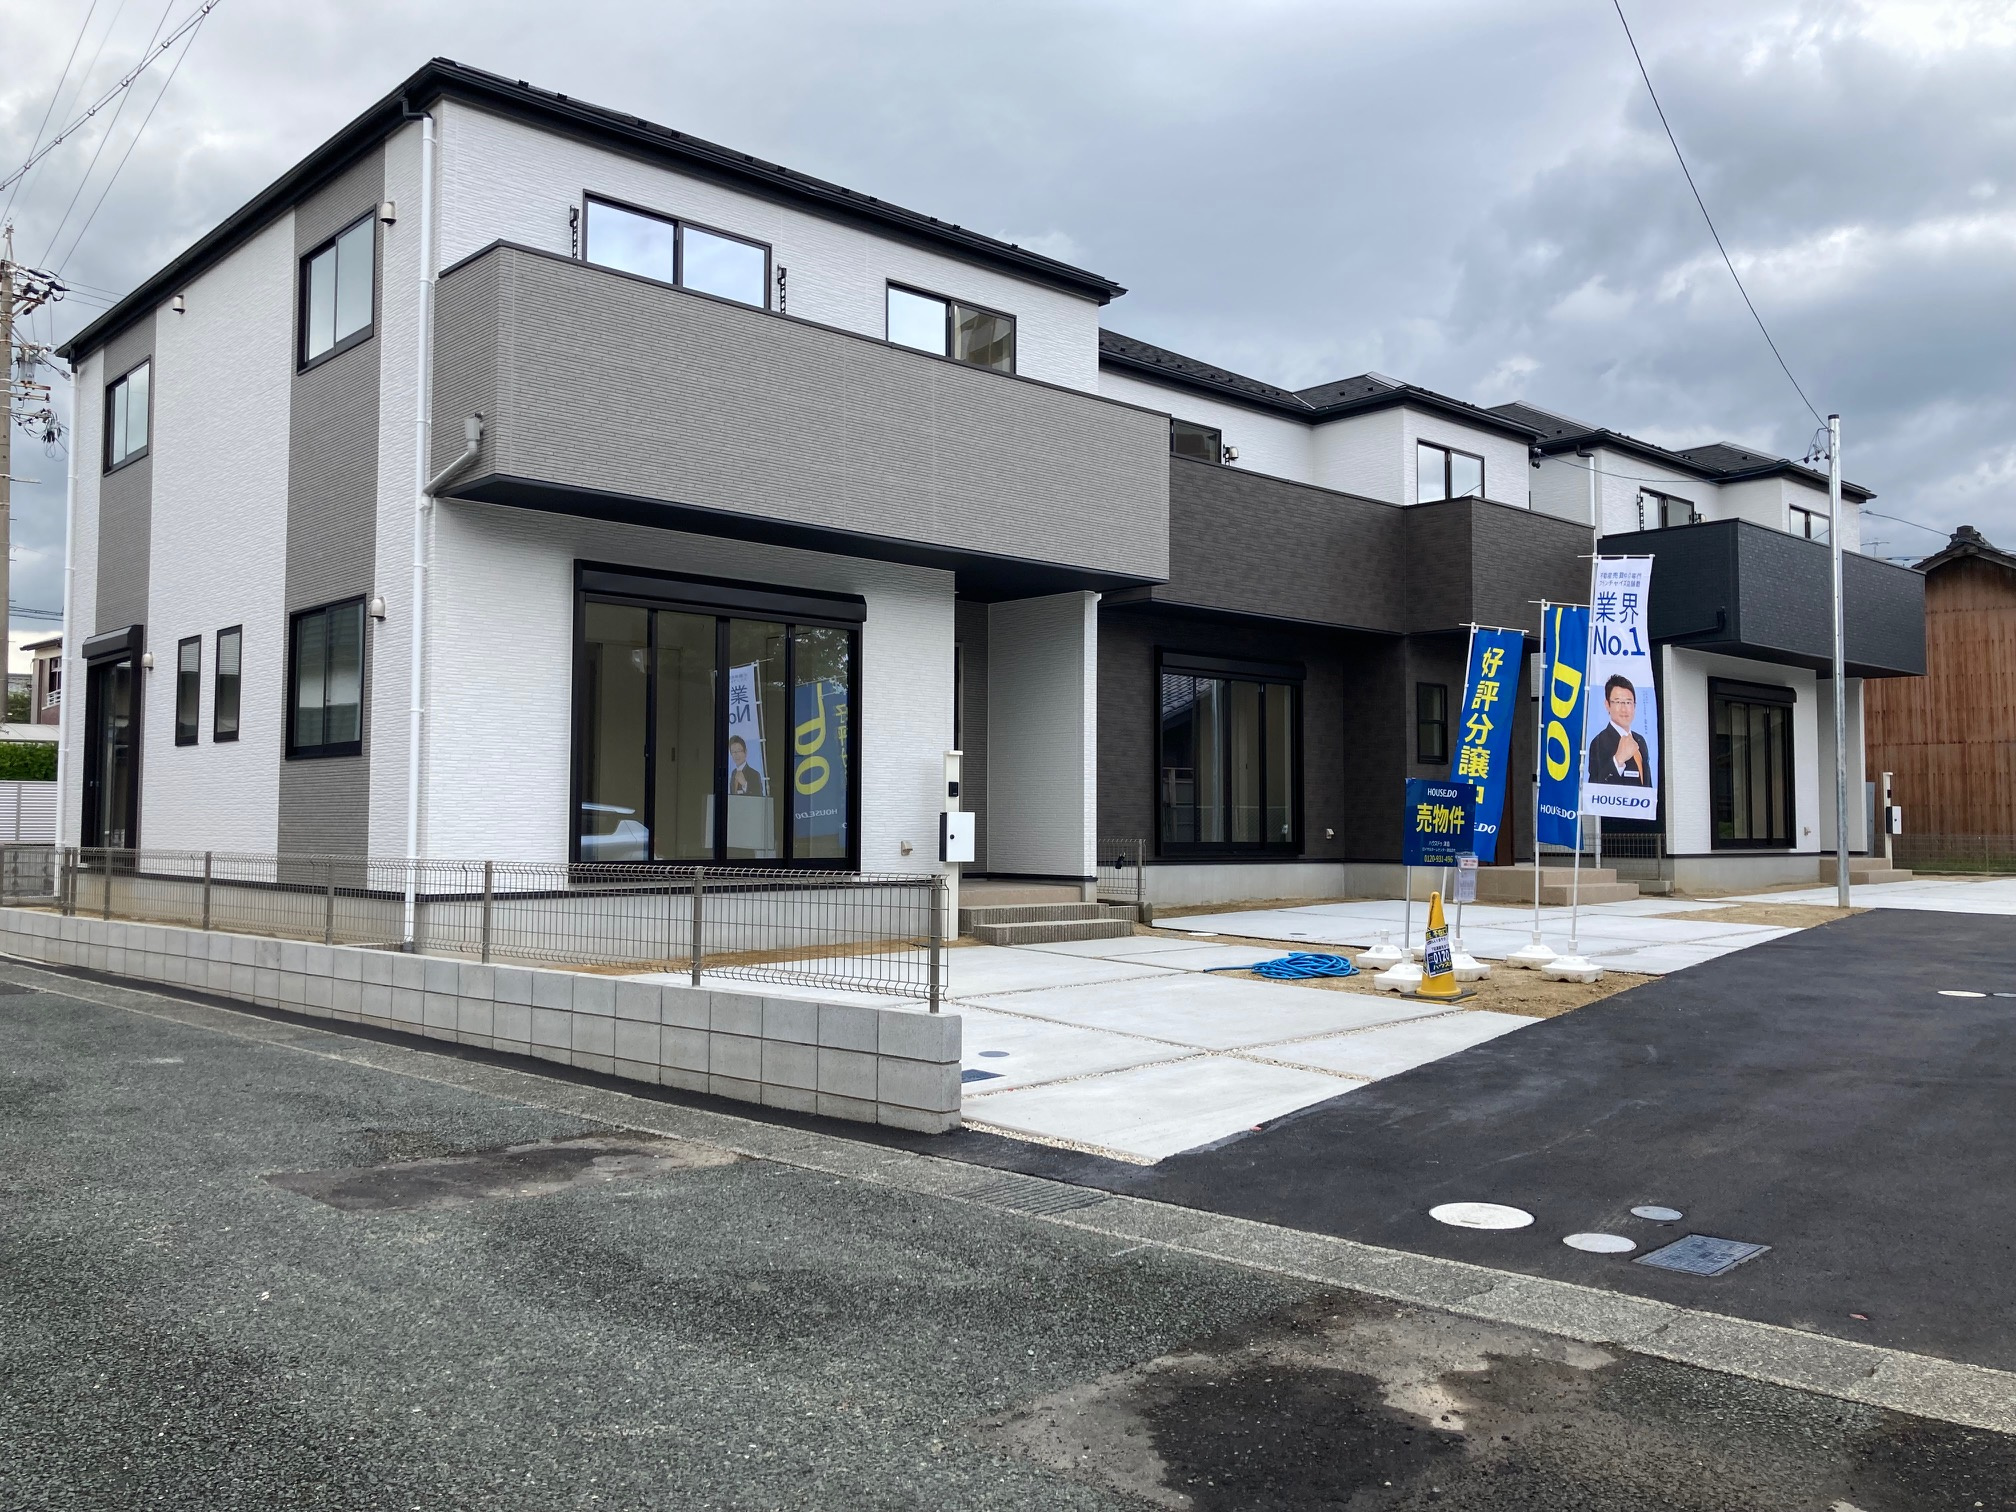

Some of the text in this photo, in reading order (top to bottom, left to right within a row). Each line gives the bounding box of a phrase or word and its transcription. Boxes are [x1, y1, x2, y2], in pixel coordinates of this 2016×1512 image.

[1595, 591, 1639, 625] 業界
[1593, 625, 1646, 656] No.1
[1415, 802, 1466, 835] 売物件
